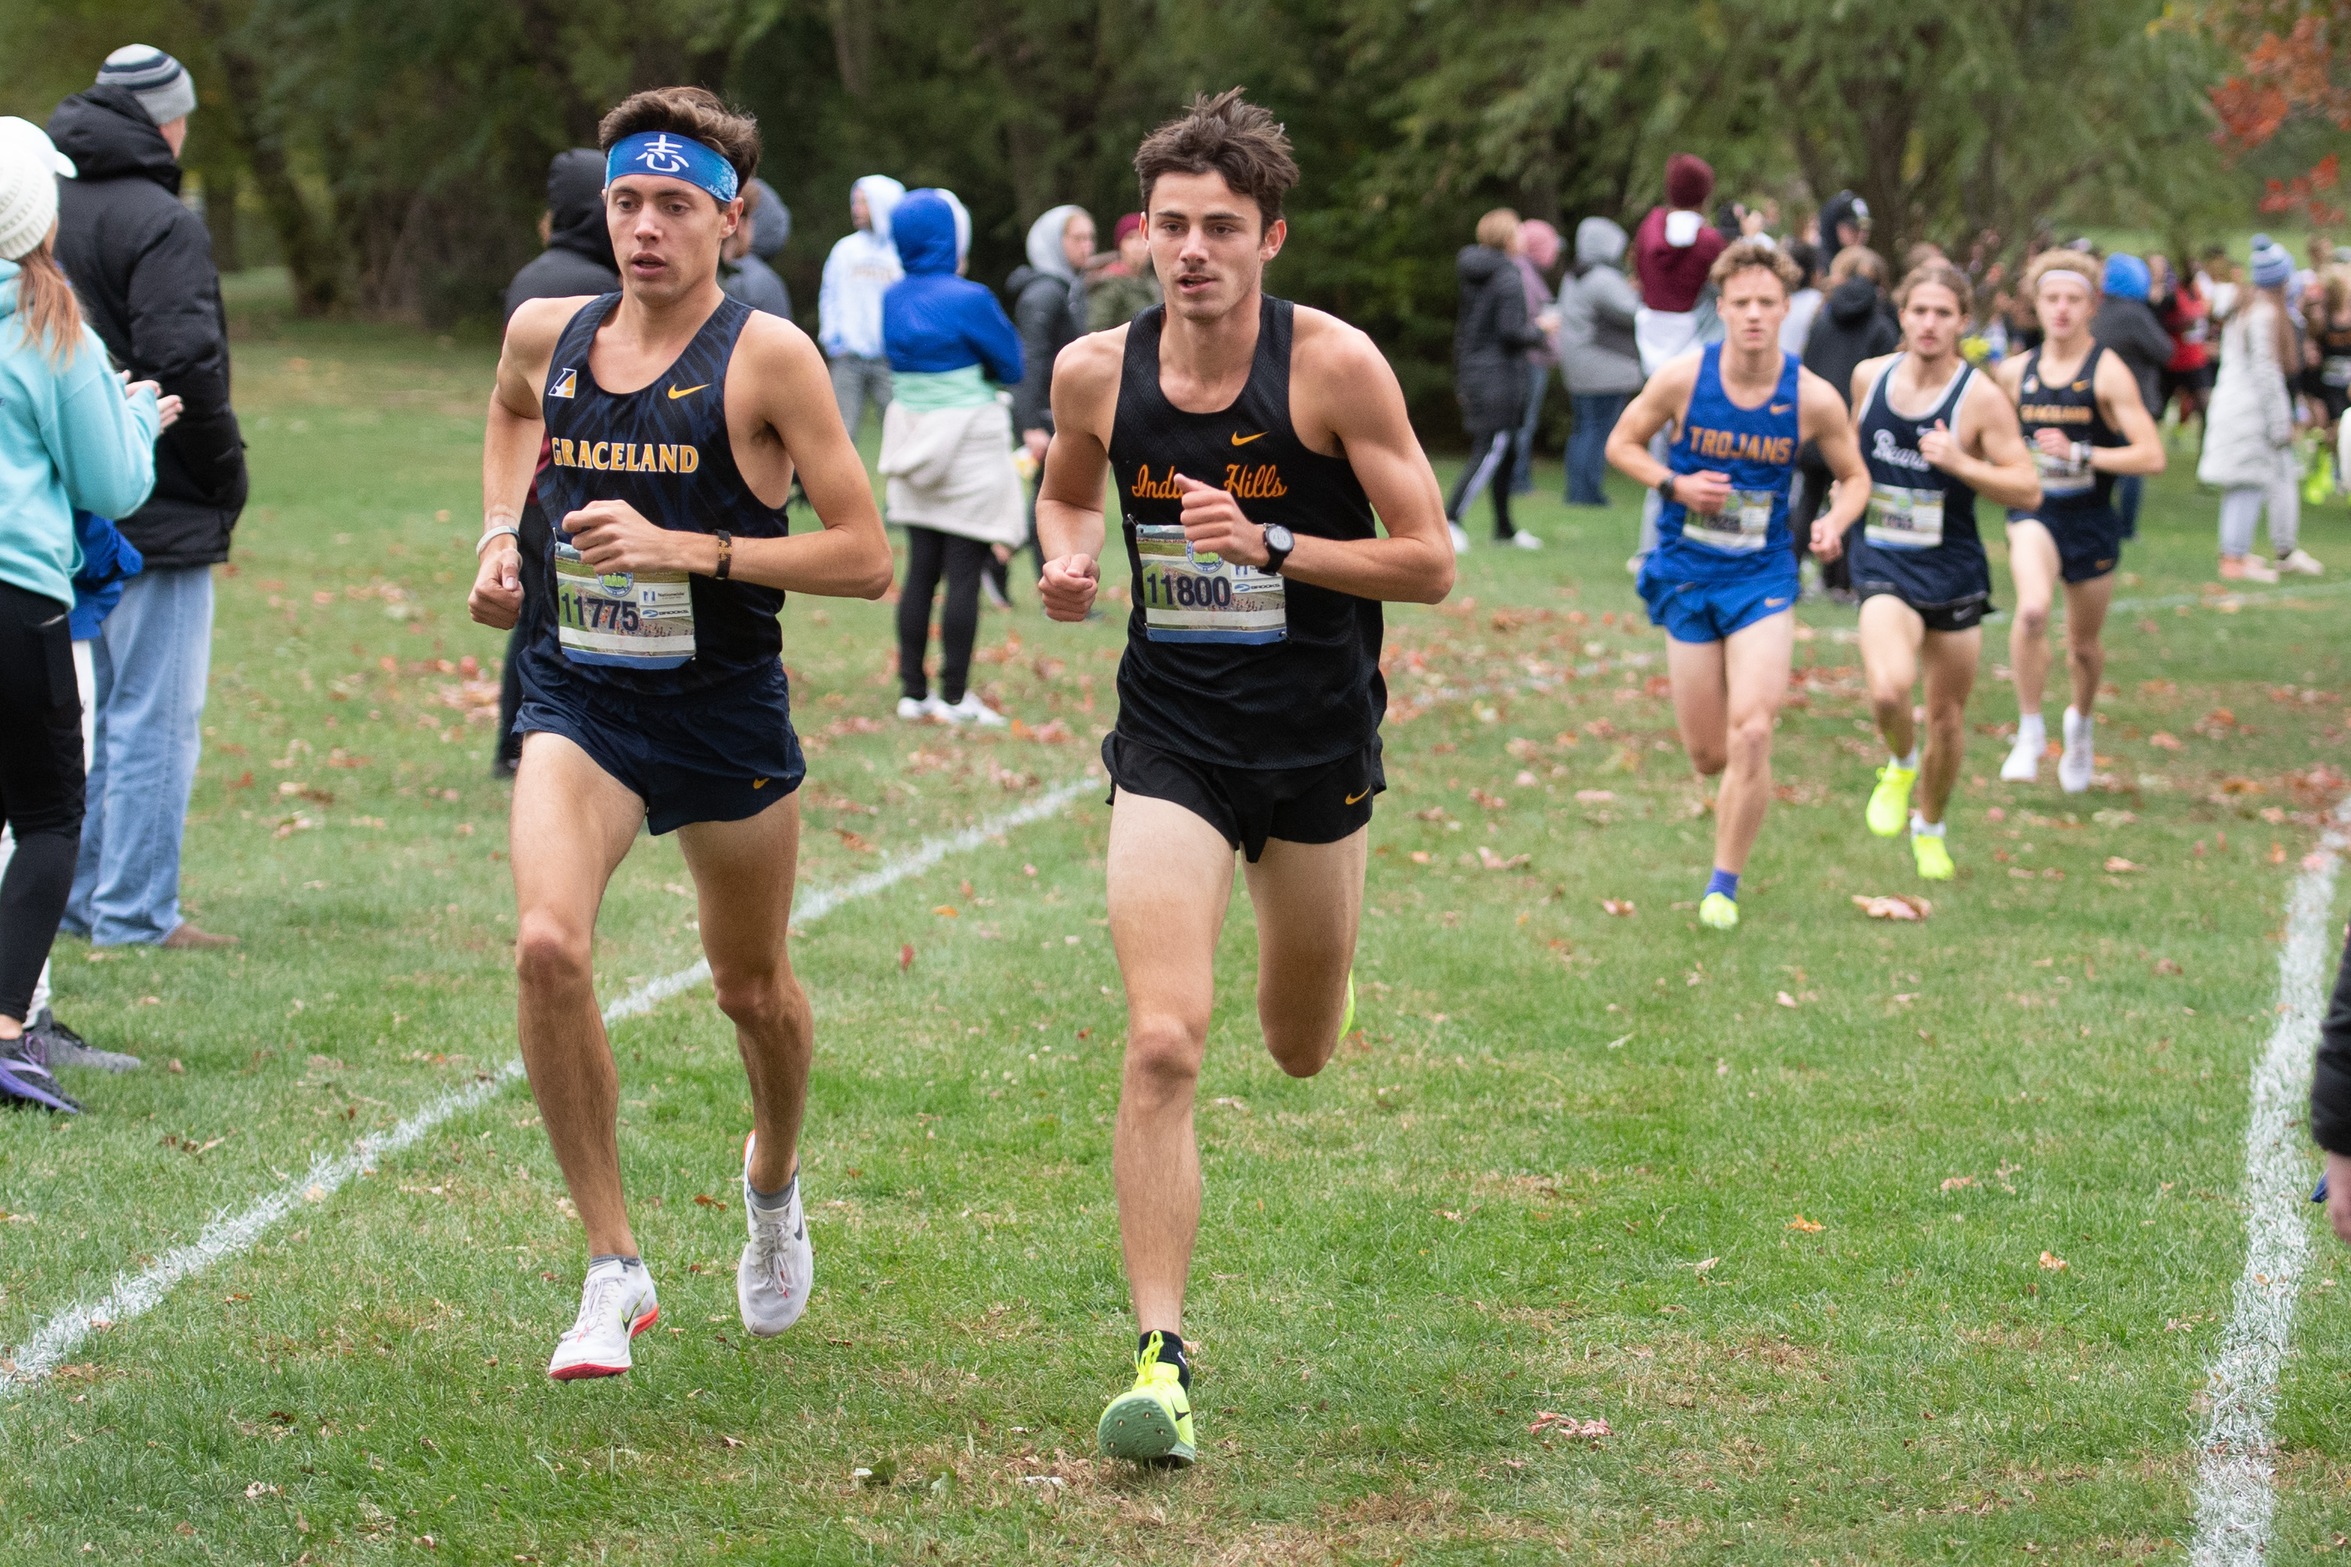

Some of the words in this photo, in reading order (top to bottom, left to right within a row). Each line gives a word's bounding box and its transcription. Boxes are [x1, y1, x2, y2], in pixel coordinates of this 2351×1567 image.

[551, 437, 699, 473] GRACELAND
[1689, 426, 1793, 464] TROJANS
[1223, 464, 1288, 499] Hills
[1146, 573, 1231, 607] 11800
[561, 592, 639, 632] 11775
